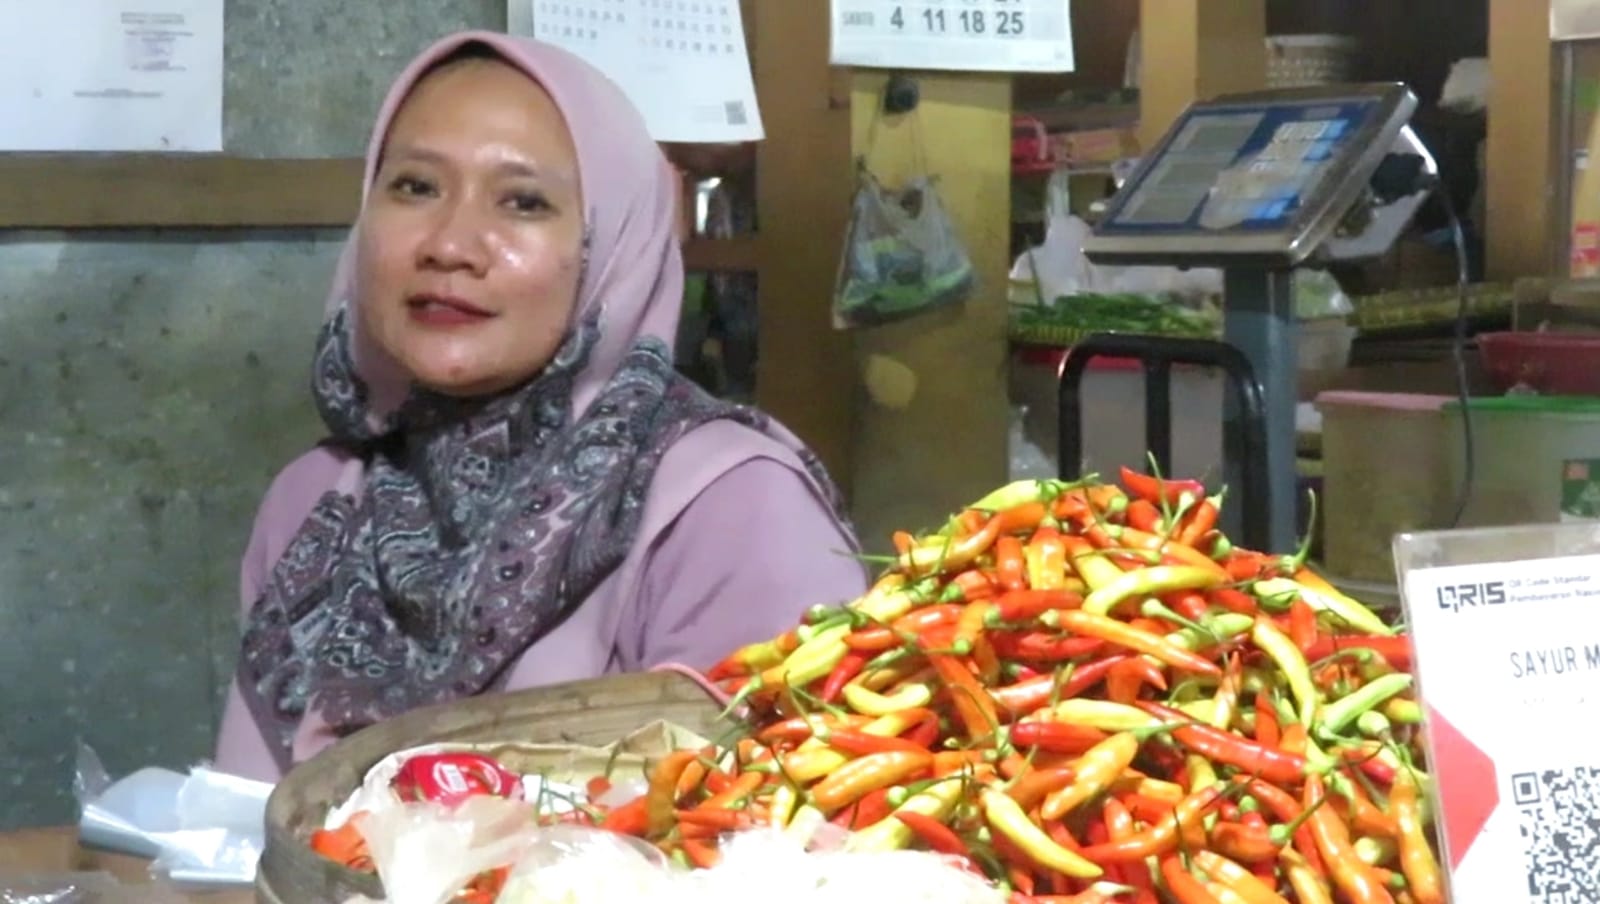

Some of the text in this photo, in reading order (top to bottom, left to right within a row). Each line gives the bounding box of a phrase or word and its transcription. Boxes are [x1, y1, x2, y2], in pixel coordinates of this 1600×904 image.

[890, 6, 904, 29] 4
[923, 8, 946, 31] 11
[960, 10, 985, 33] 18
[996, 11, 1024, 34] 25
[1437, 581, 1506, 613] QRIS
[1510, 645, 1578, 679] SAYUR
